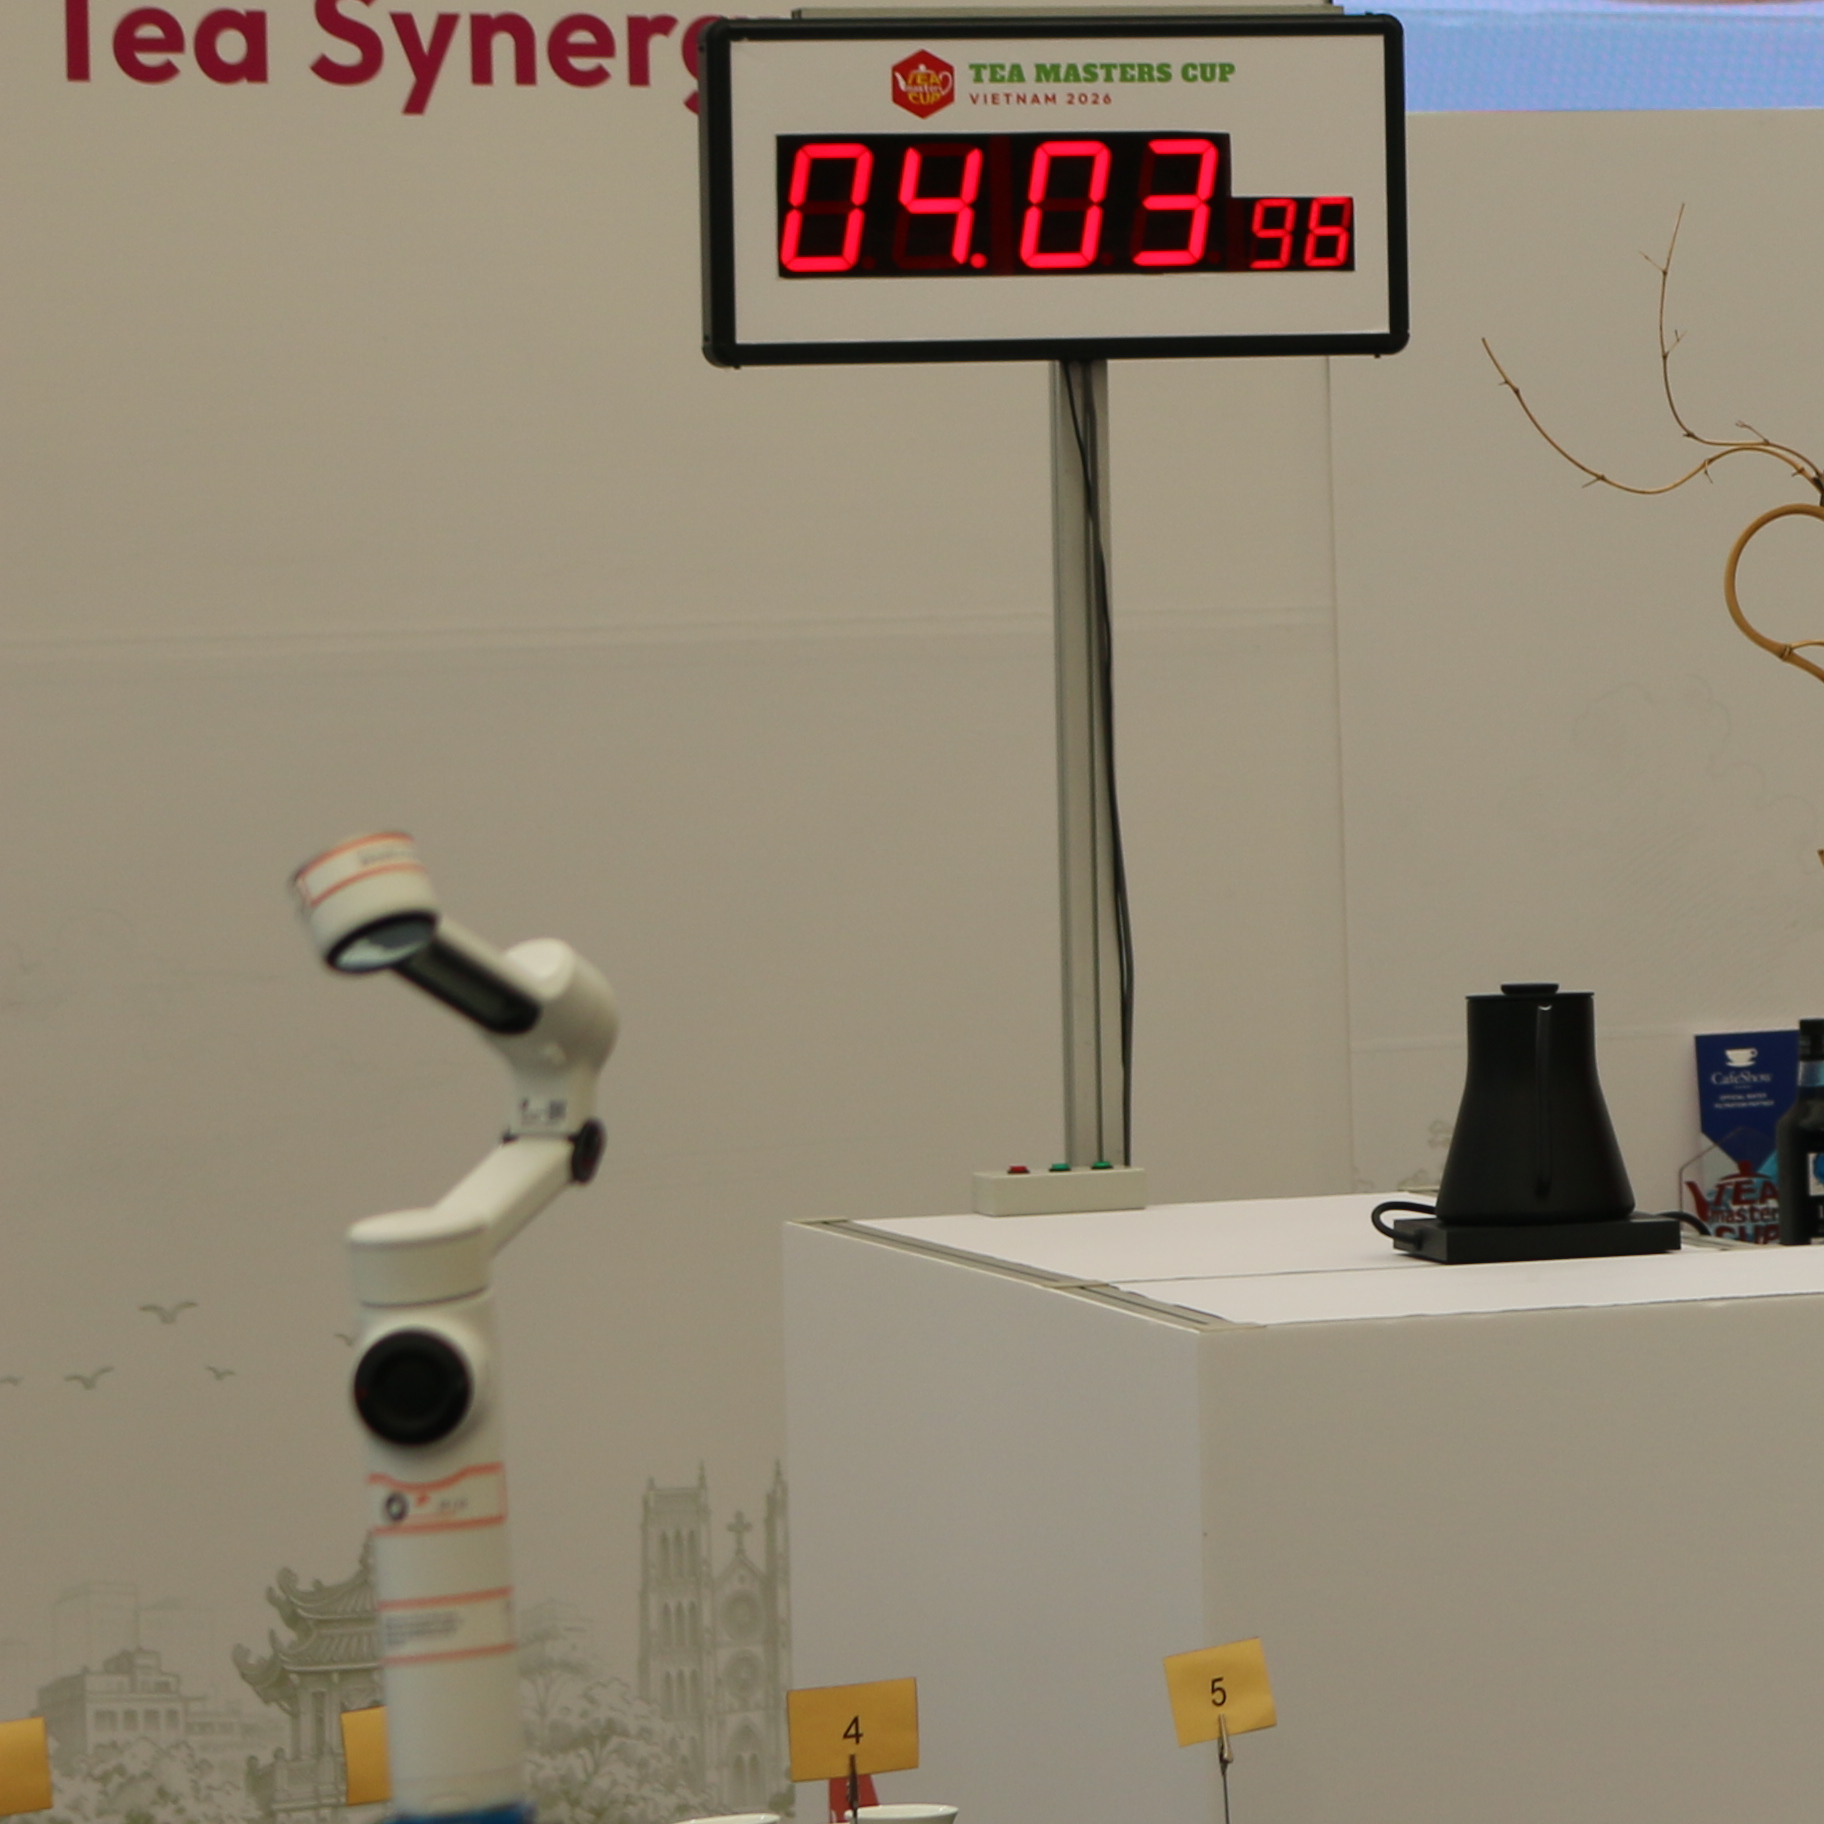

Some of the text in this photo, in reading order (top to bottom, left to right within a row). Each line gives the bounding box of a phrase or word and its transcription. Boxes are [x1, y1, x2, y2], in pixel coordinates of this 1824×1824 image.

[969, 61, 1237, 84] TEA MASTERS CUP
[969, 91, 1113, 106] VIETNAM 2026
[779, 138, 1220, 273] 04.03
[1211, 1677, 1226, 1706] 5
[843, 1716, 863, 1744] 4
